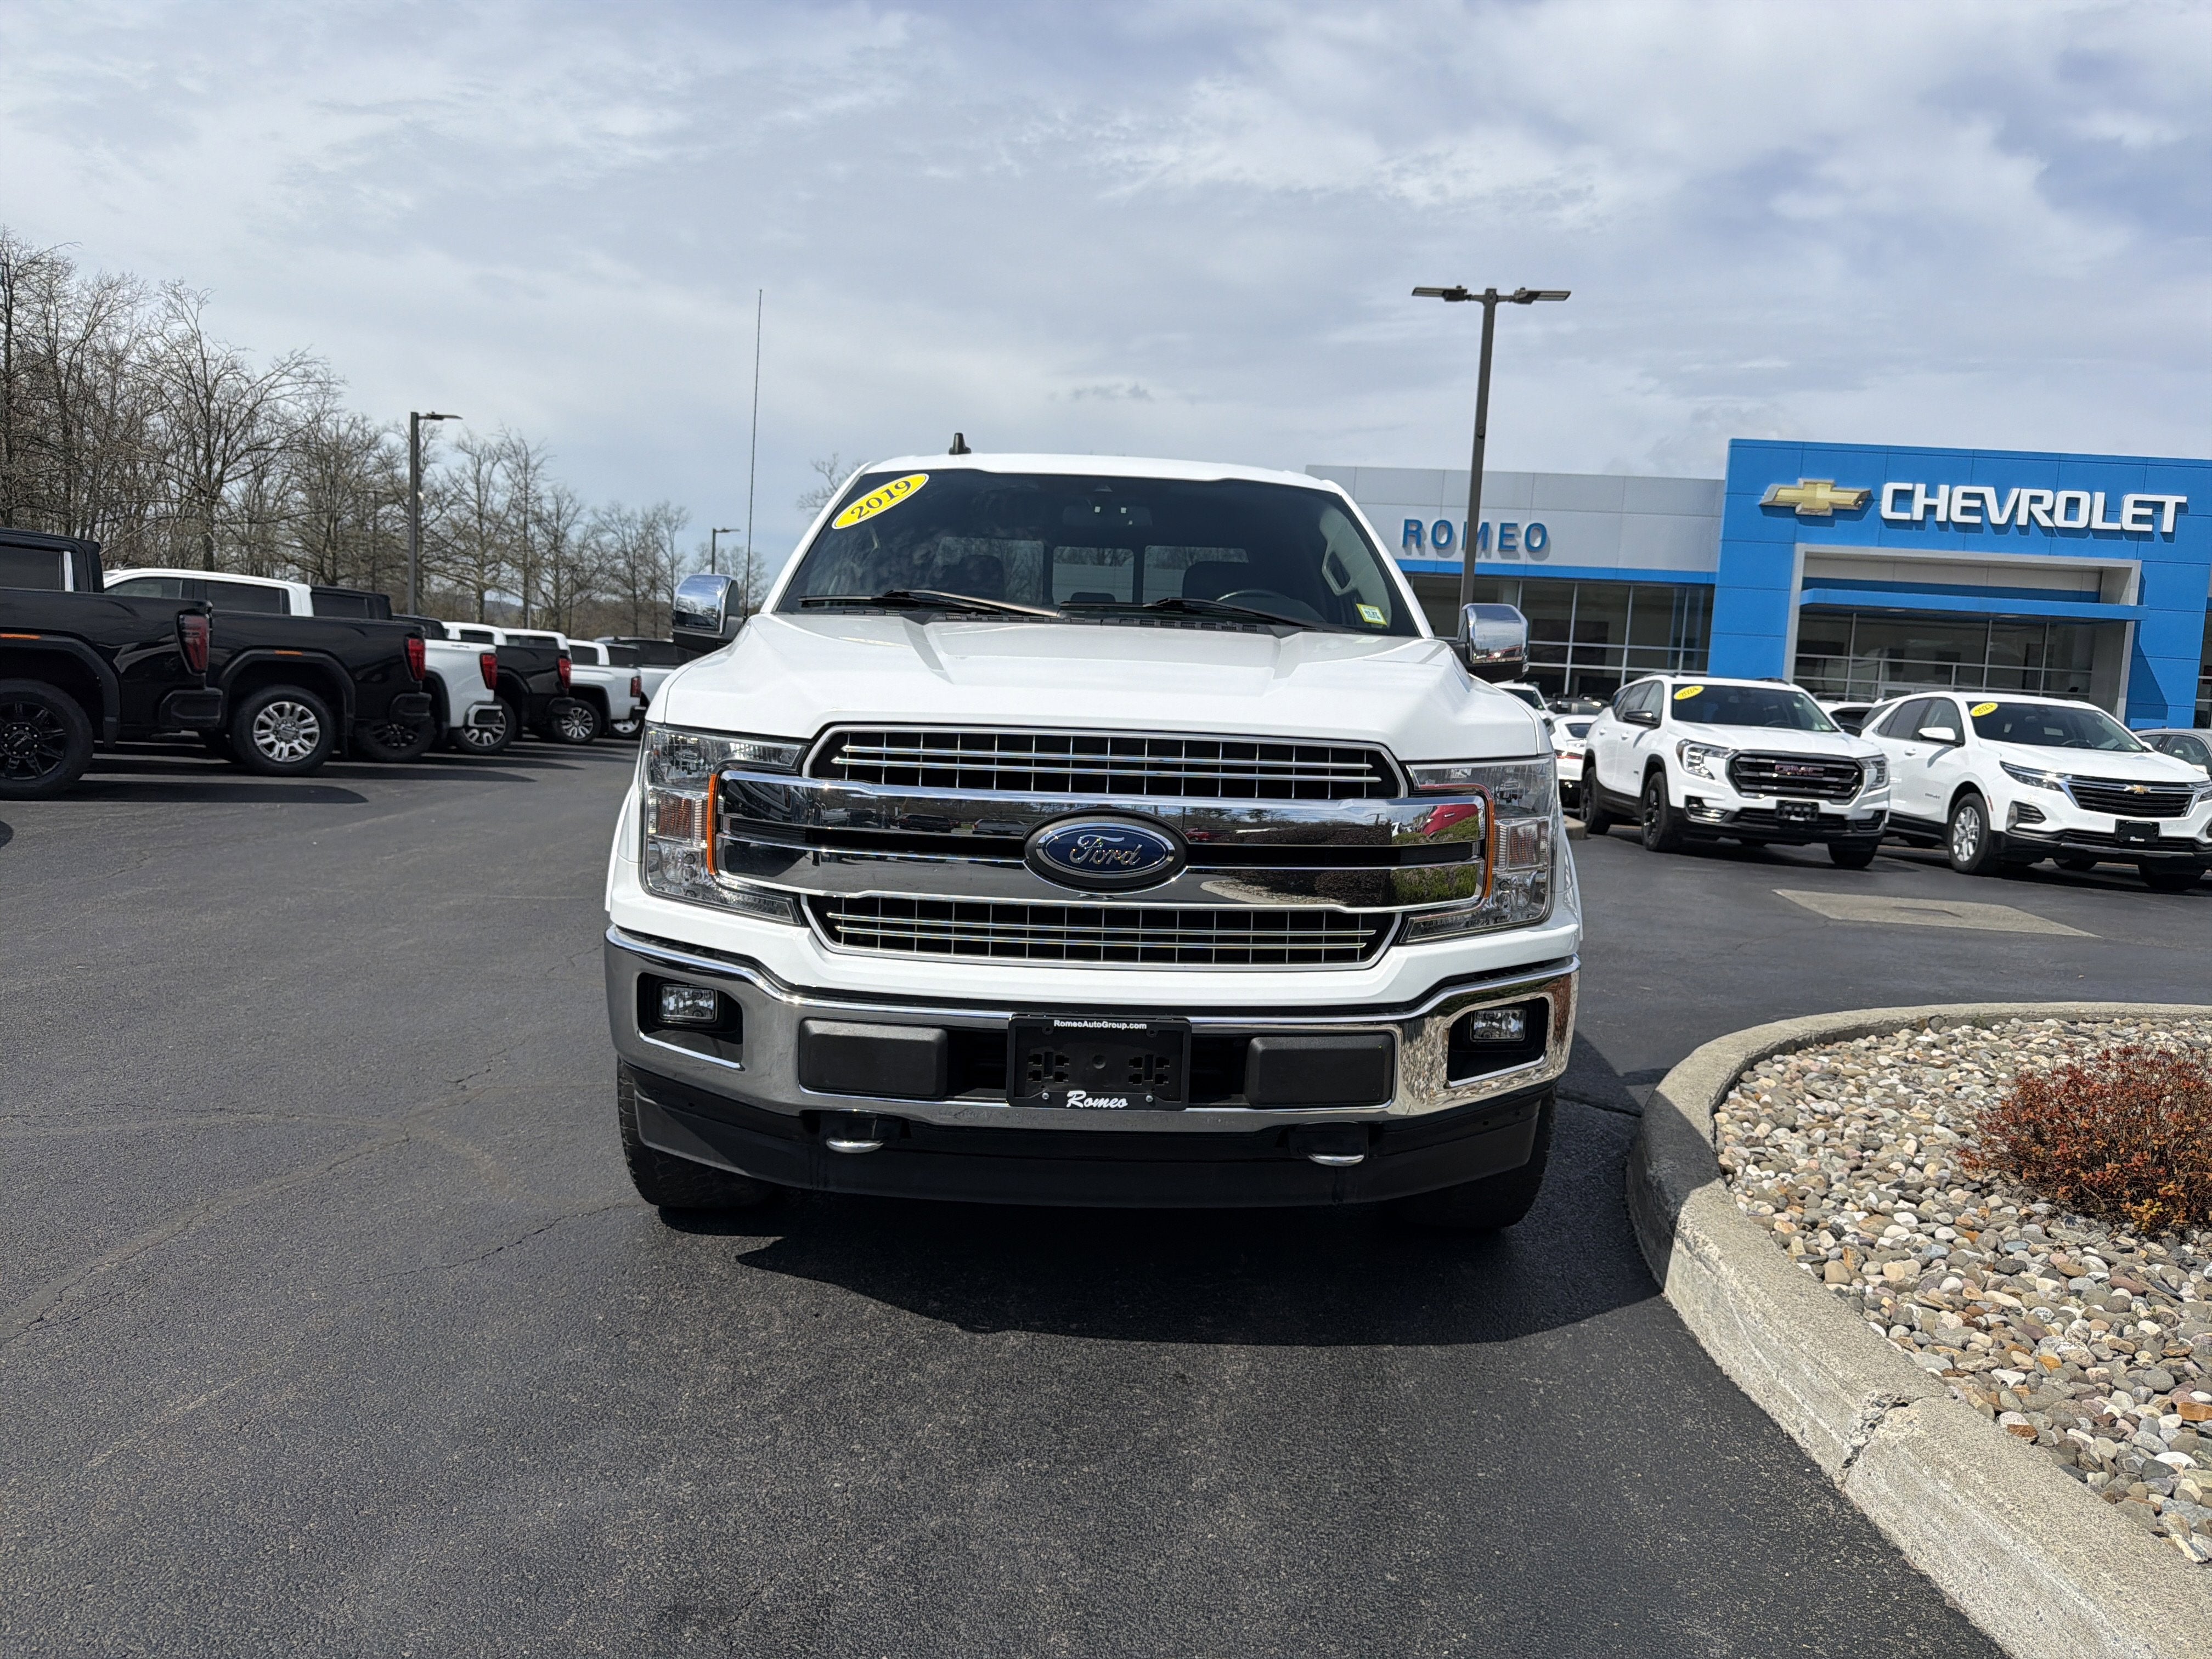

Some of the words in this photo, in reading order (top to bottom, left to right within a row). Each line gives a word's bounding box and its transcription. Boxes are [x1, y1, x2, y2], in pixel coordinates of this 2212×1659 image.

[850, 480, 911, 520] 2019
[1881, 482, 2187, 533] CHEVROLET
[1402, 519, 1547, 552] ROMEO
[1775, 764, 1825, 777] GMC
[1069, 834, 1143, 866] Ford
[1053, 1019, 1147, 1030] RomeoAutoGroup.com
[1066, 1090, 1128, 1108] Romeo
